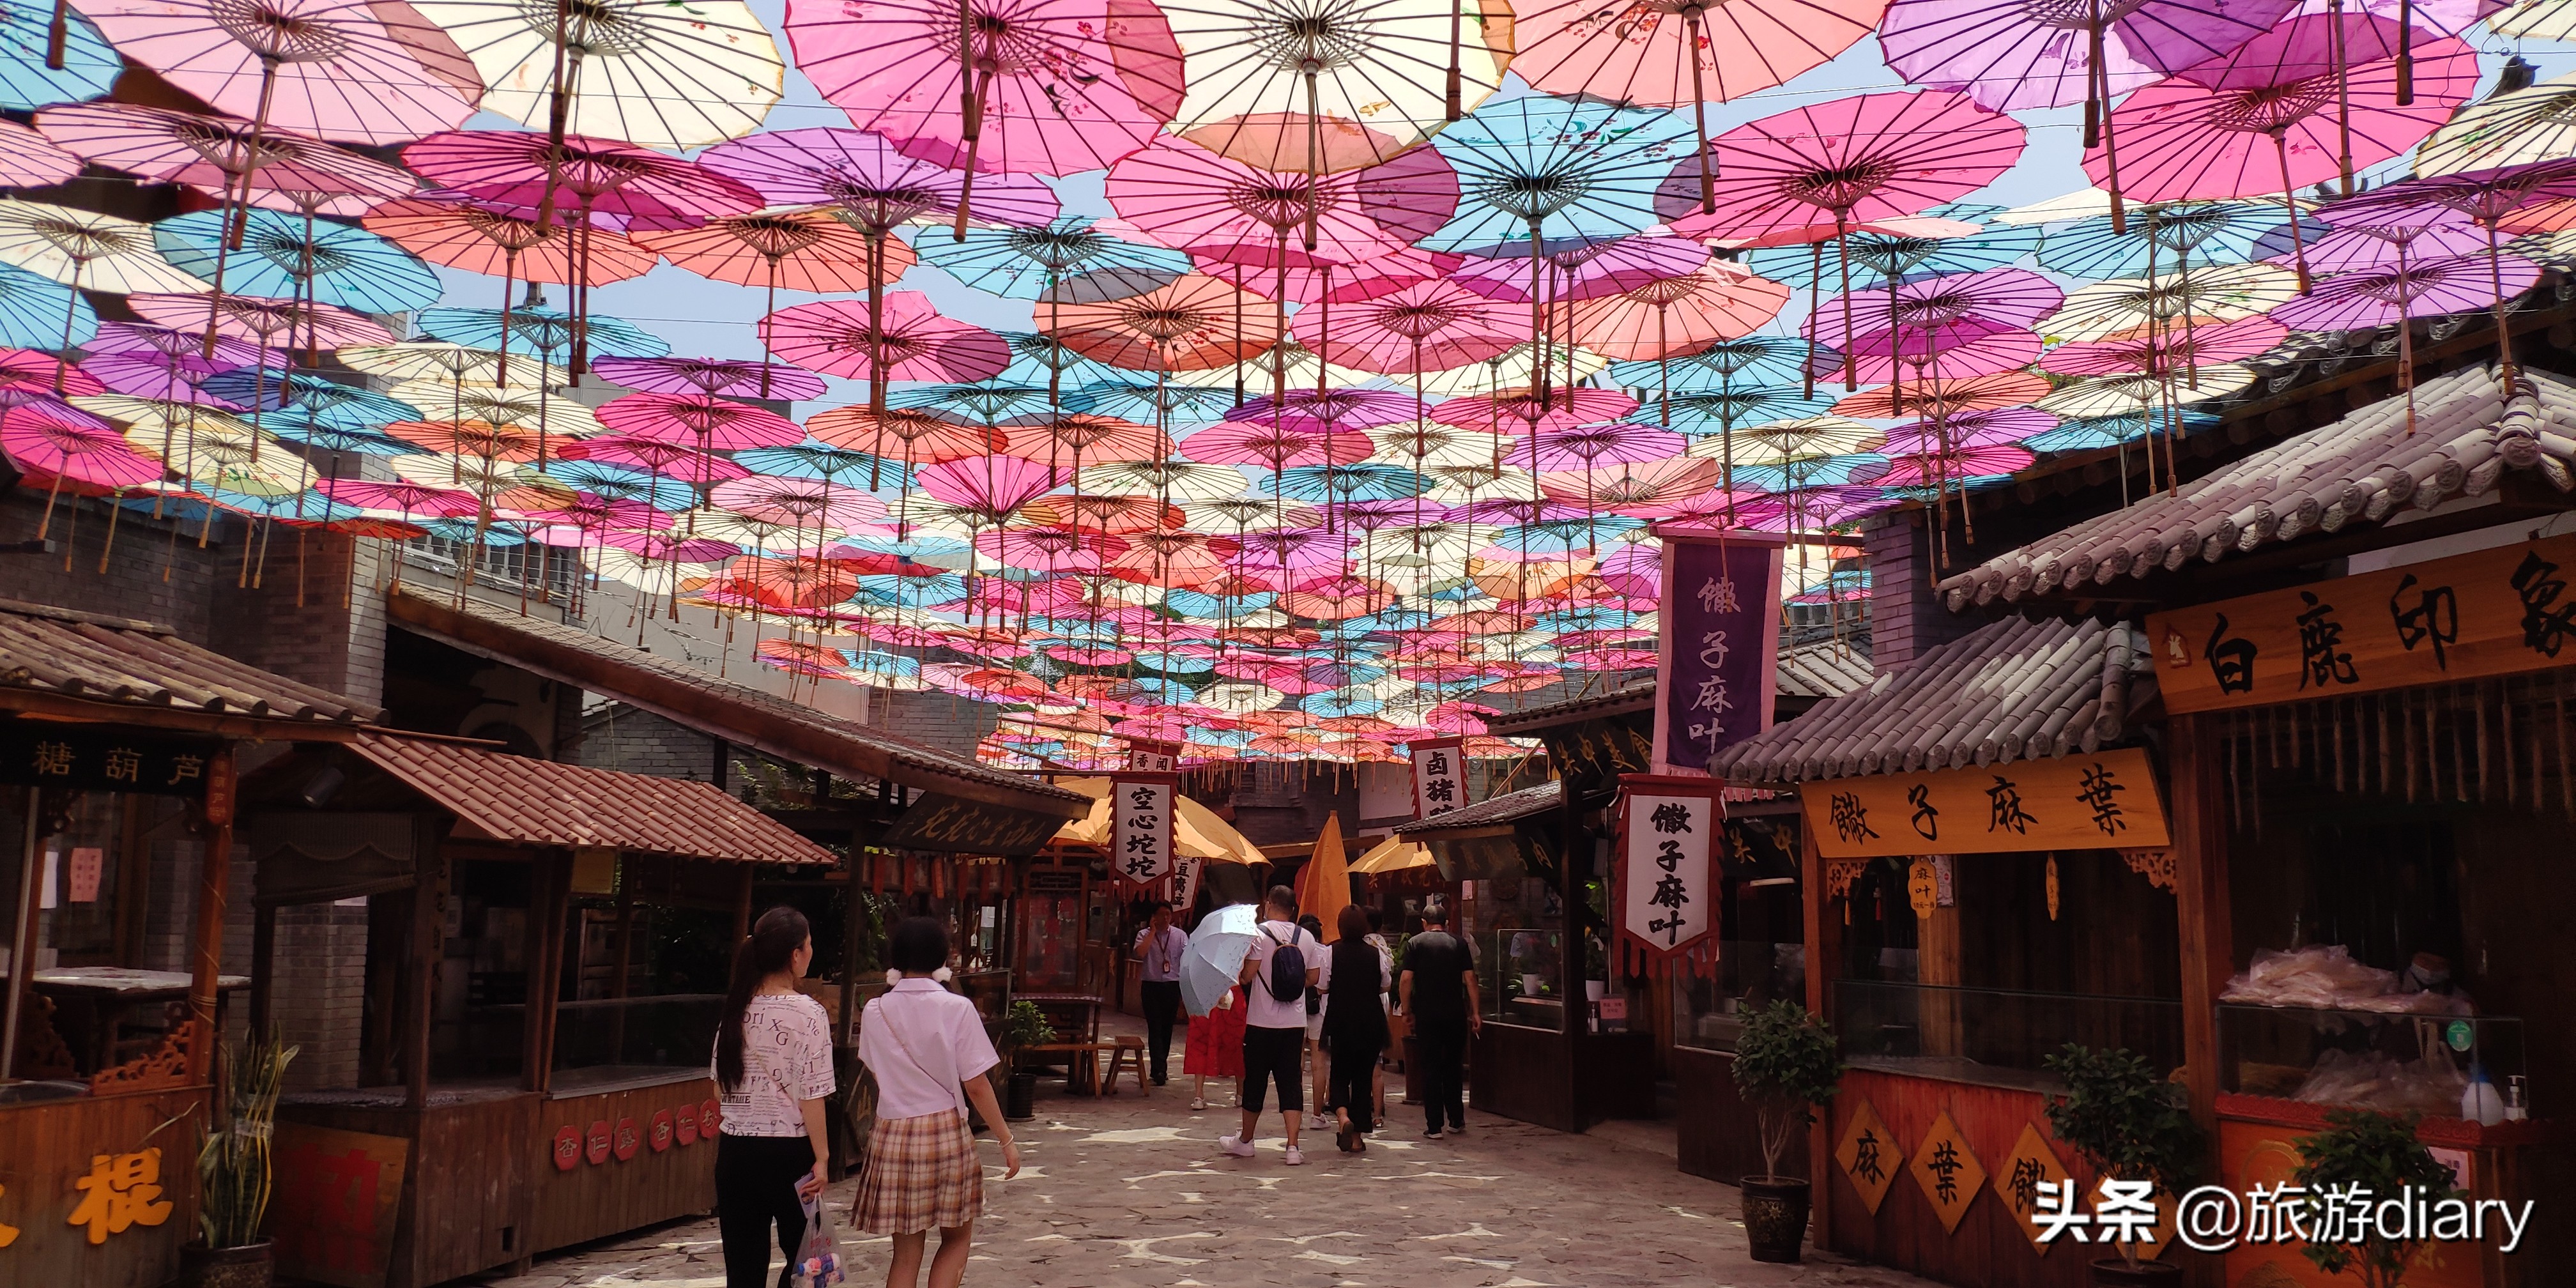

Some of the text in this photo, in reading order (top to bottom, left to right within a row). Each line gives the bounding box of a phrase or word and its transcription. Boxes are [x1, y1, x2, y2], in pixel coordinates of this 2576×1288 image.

[2204, 550, 2576, 696] 白鹿印象
[32, 740, 204, 786] 糖葫芦
[1126, 786, 1158, 877] 空心坨坨
